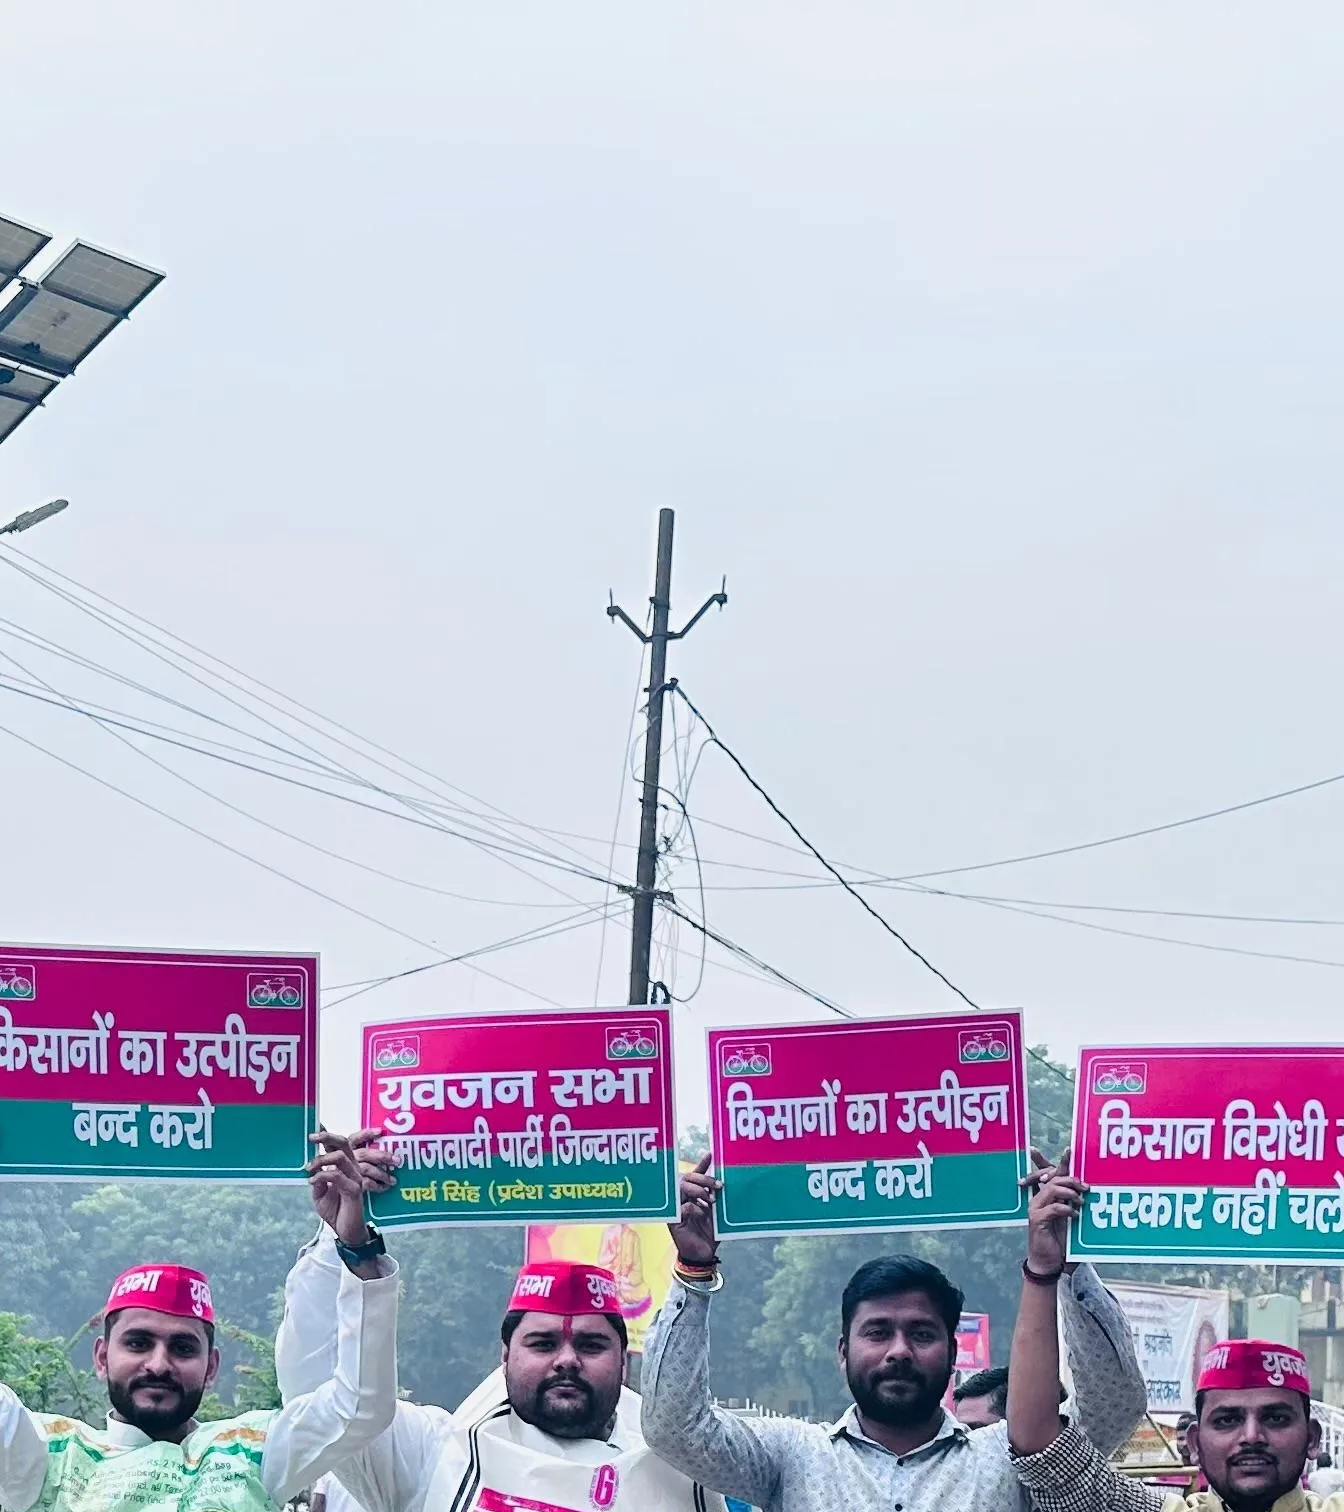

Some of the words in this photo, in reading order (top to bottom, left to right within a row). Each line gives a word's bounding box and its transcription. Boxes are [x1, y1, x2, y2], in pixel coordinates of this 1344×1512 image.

[118, 1030, 167, 1076] का
[174, 1012, 301, 1095] उत्पीड़न
[72, 1102, 142, 1148] बन्द
[148, 1087, 216, 1150] करो
[377, 1070, 538, 1134] युवजन
[548, 1067, 654, 1107] सभा
[726, 1078, 841, 1141] किसानों
[844, 1092, 889, 1135] का
[894, 1069, 1009, 1144] उत्पीड़न
[1098, 1098, 1215, 1161] किसान
[1222, 1098, 1328, 1161] विरोधी
[496, 1114, 544, 1168] पार्टी
[549, 1113, 660, 1167] जिन्दाबाद
[806, 1160, 867, 1202] बन्द
[873, 1140, 934, 1200] करो
[400, 1180, 438, 1203] पार्थ
[441, 1179, 482, 1203] सिंह
[488, 1180, 544, 1207] (प्रदेश
[547, 1175, 634, 1204] उपाध्यक्ष)
[1089, 1185, 1209, 1230] सरकार
[1211, 1168, 1287, 1236] नहीं
[117, 1270, 163, 1296] सभा
[519, 1275, 555, 1298] सभा
